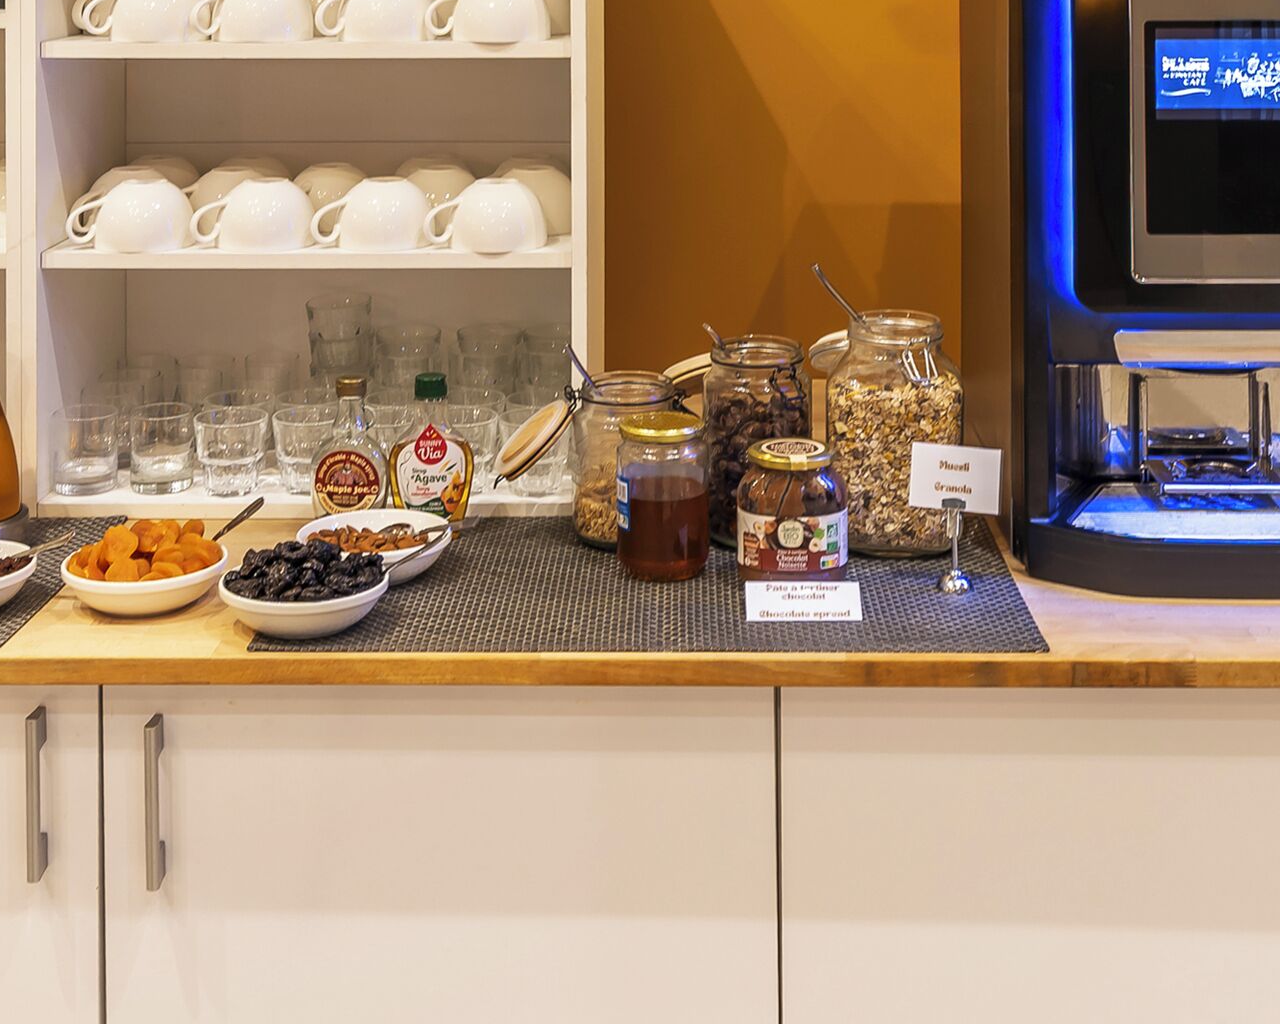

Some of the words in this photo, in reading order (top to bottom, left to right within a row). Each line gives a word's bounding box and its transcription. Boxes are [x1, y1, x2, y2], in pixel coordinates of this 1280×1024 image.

[417, 446, 444, 461] Via
[938, 459, 970, 472] Muesli
[322, 483, 353, 495] Maple
[934, 481, 972, 494] Granola
[781, 593, 826, 601] chocolat
[759, 610, 811, 618] Chocolate
[813, 610, 851, 620] spread
